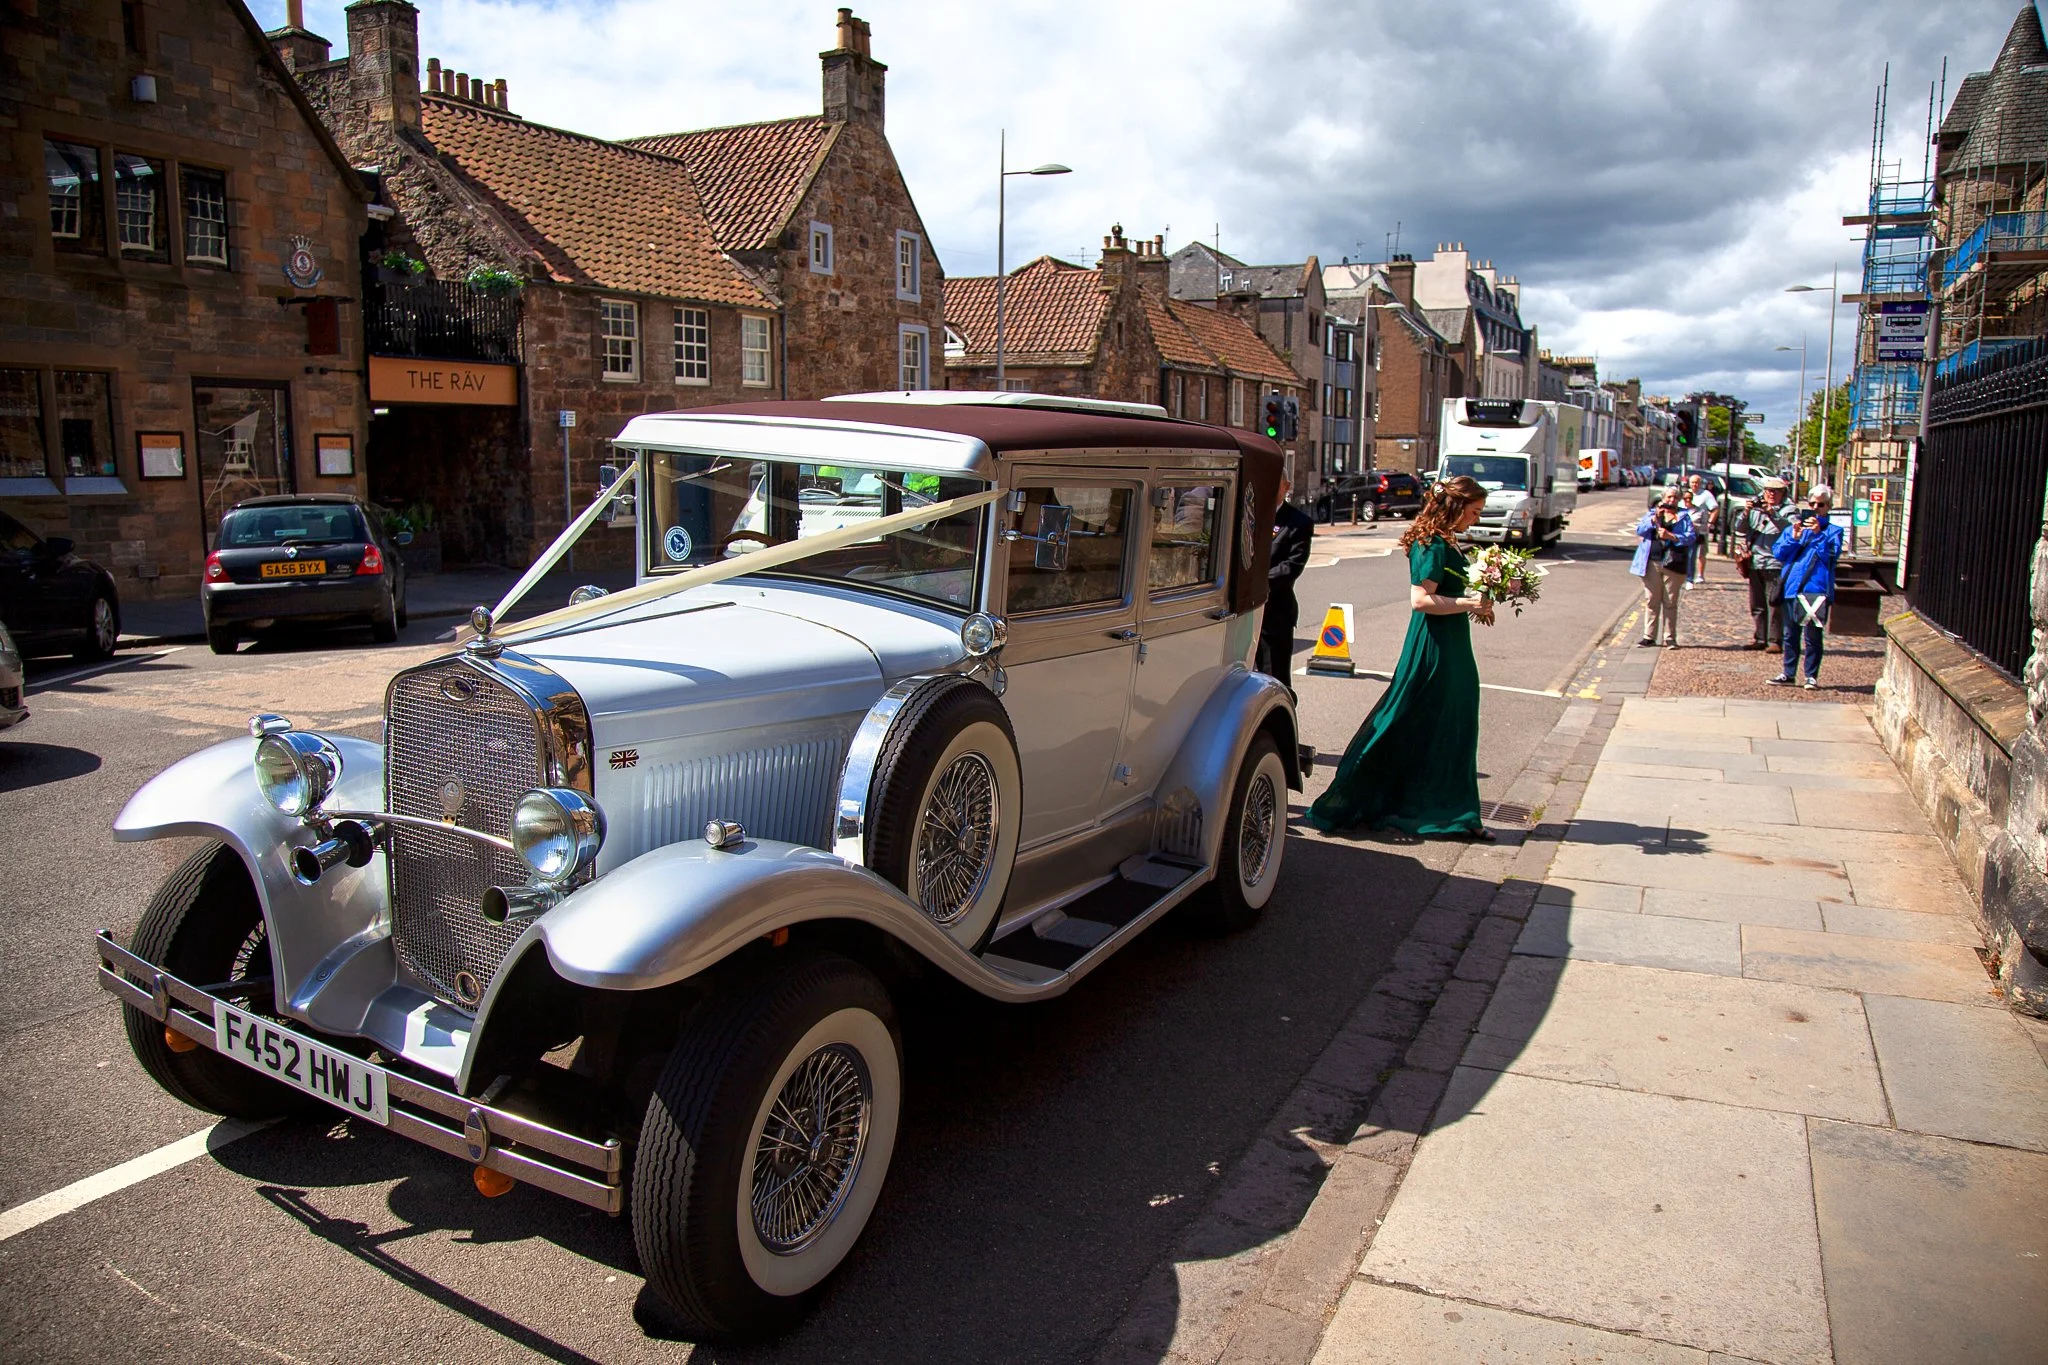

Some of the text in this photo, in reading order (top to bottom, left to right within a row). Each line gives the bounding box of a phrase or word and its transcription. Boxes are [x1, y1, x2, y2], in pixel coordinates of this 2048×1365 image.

[406, 370, 486, 391] THE RÄV
[266, 564, 296, 576] SA56
[300, 562, 320, 573] BYX
[225, 1011, 373, 1112] F452 HWJ
